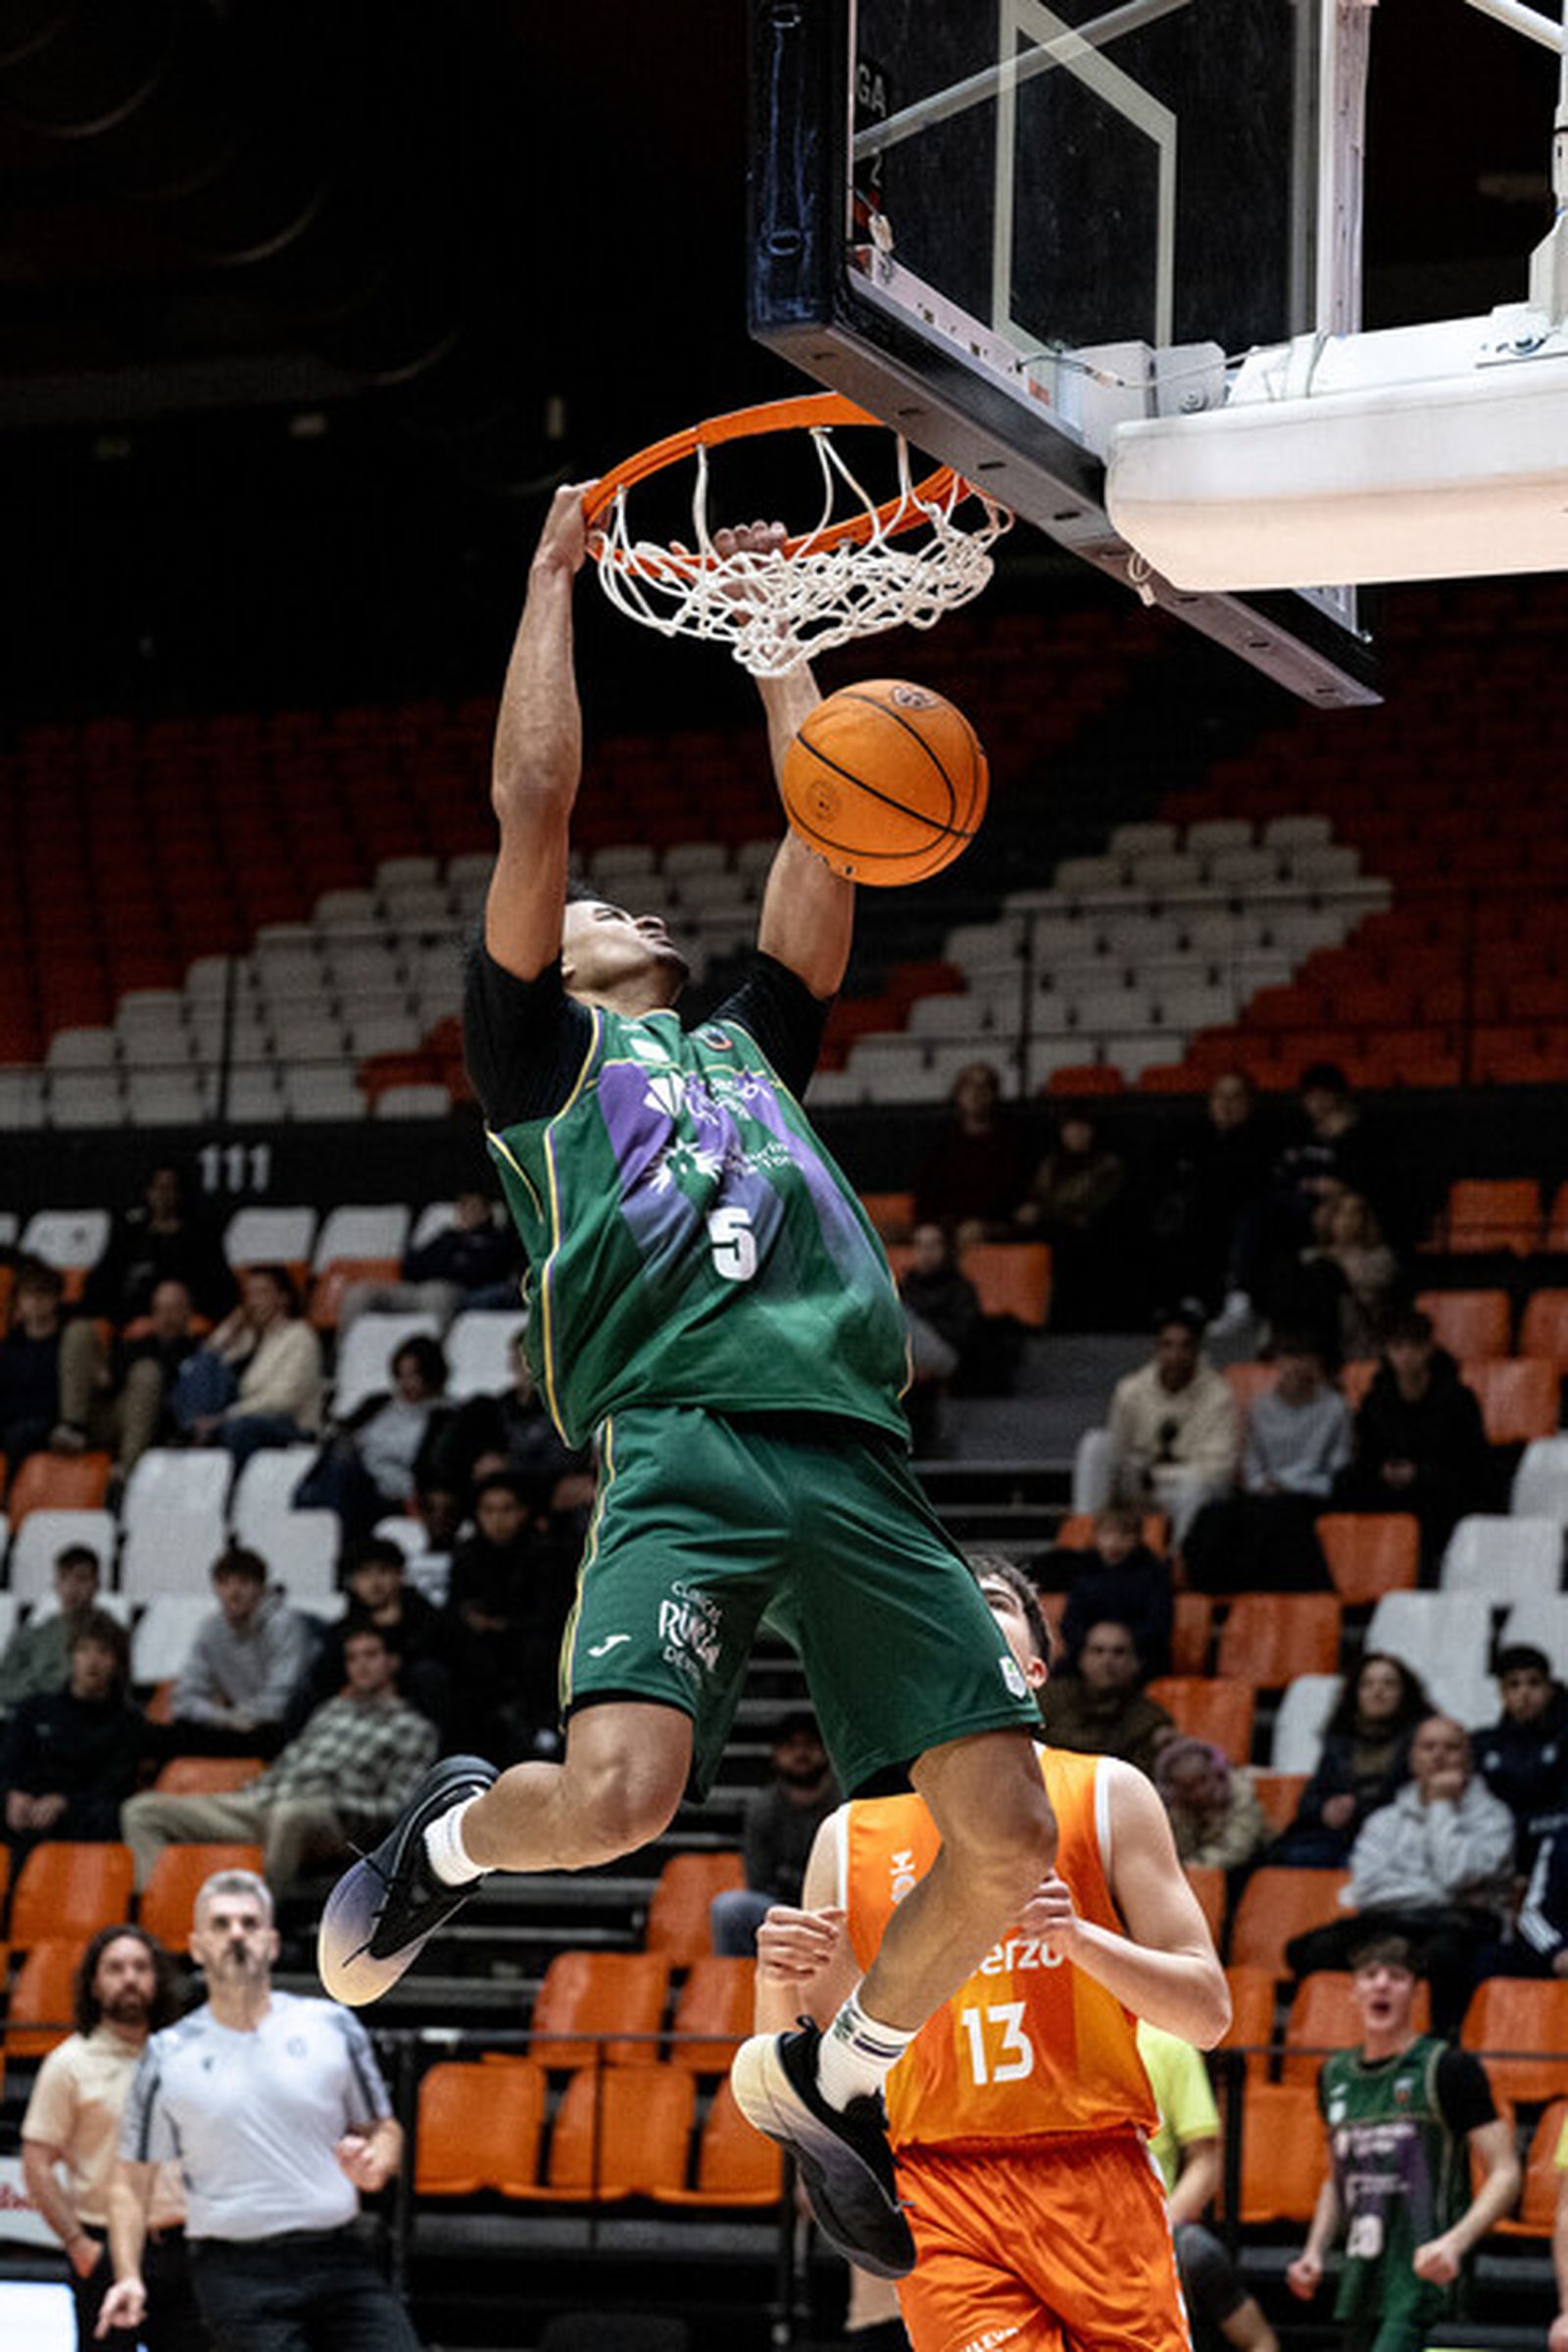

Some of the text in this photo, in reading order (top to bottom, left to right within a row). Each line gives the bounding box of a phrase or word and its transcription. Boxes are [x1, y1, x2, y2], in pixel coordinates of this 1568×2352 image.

[198, 1143, 270, 1193] 111
[707, 1207, 757, 1282] 5
[969, 1938, 1064, 1975] erzo
[959, 2001, 1034, 2085] 13
